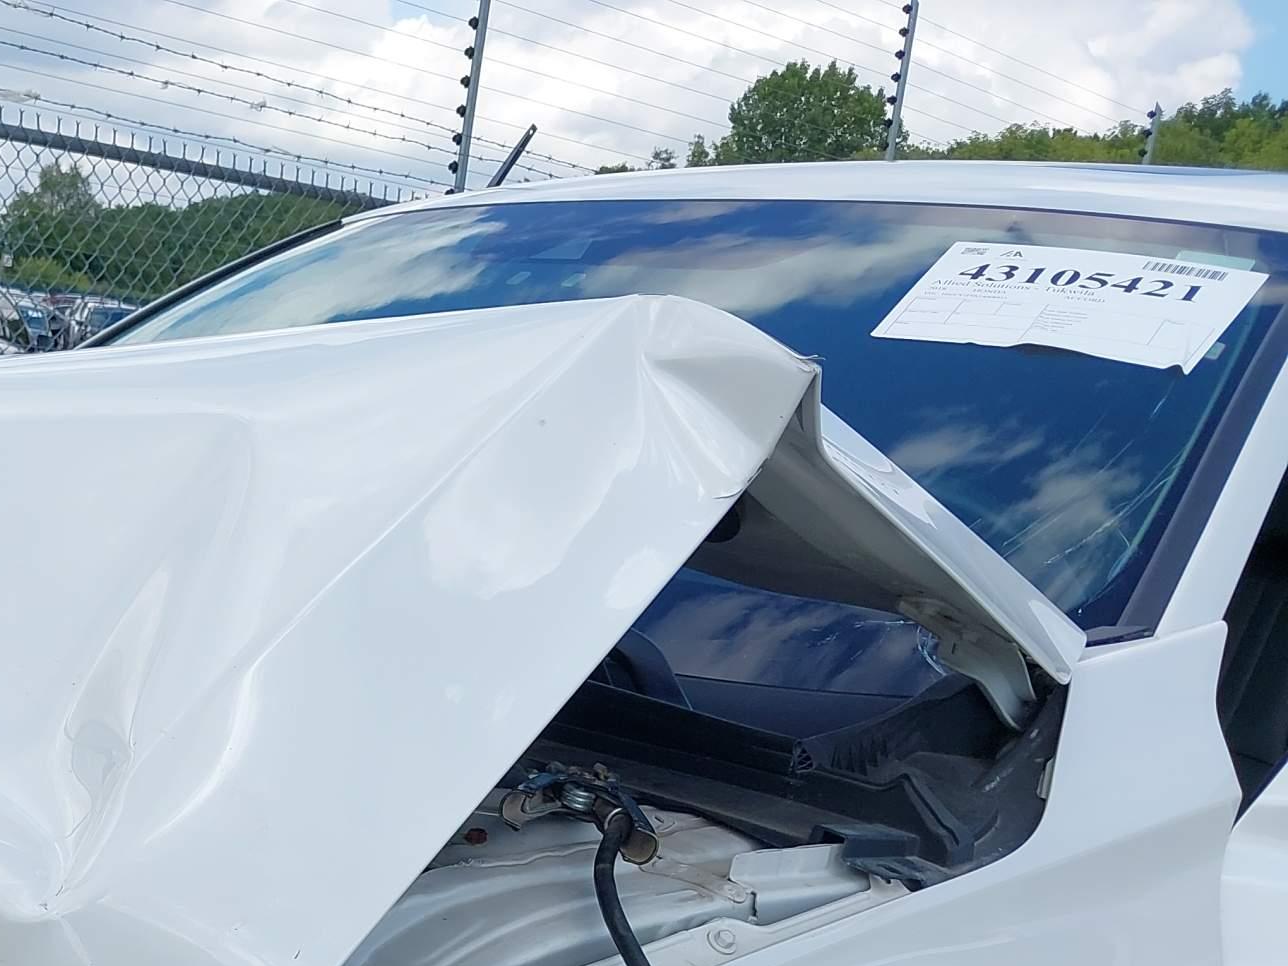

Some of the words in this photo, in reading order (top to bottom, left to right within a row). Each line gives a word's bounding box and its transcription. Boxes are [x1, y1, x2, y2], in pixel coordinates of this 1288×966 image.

[930, 279, 971, 288] Allied
[974, 281, 1029, 292] Solutions
[958, 263, 1202, 303] 43105421
